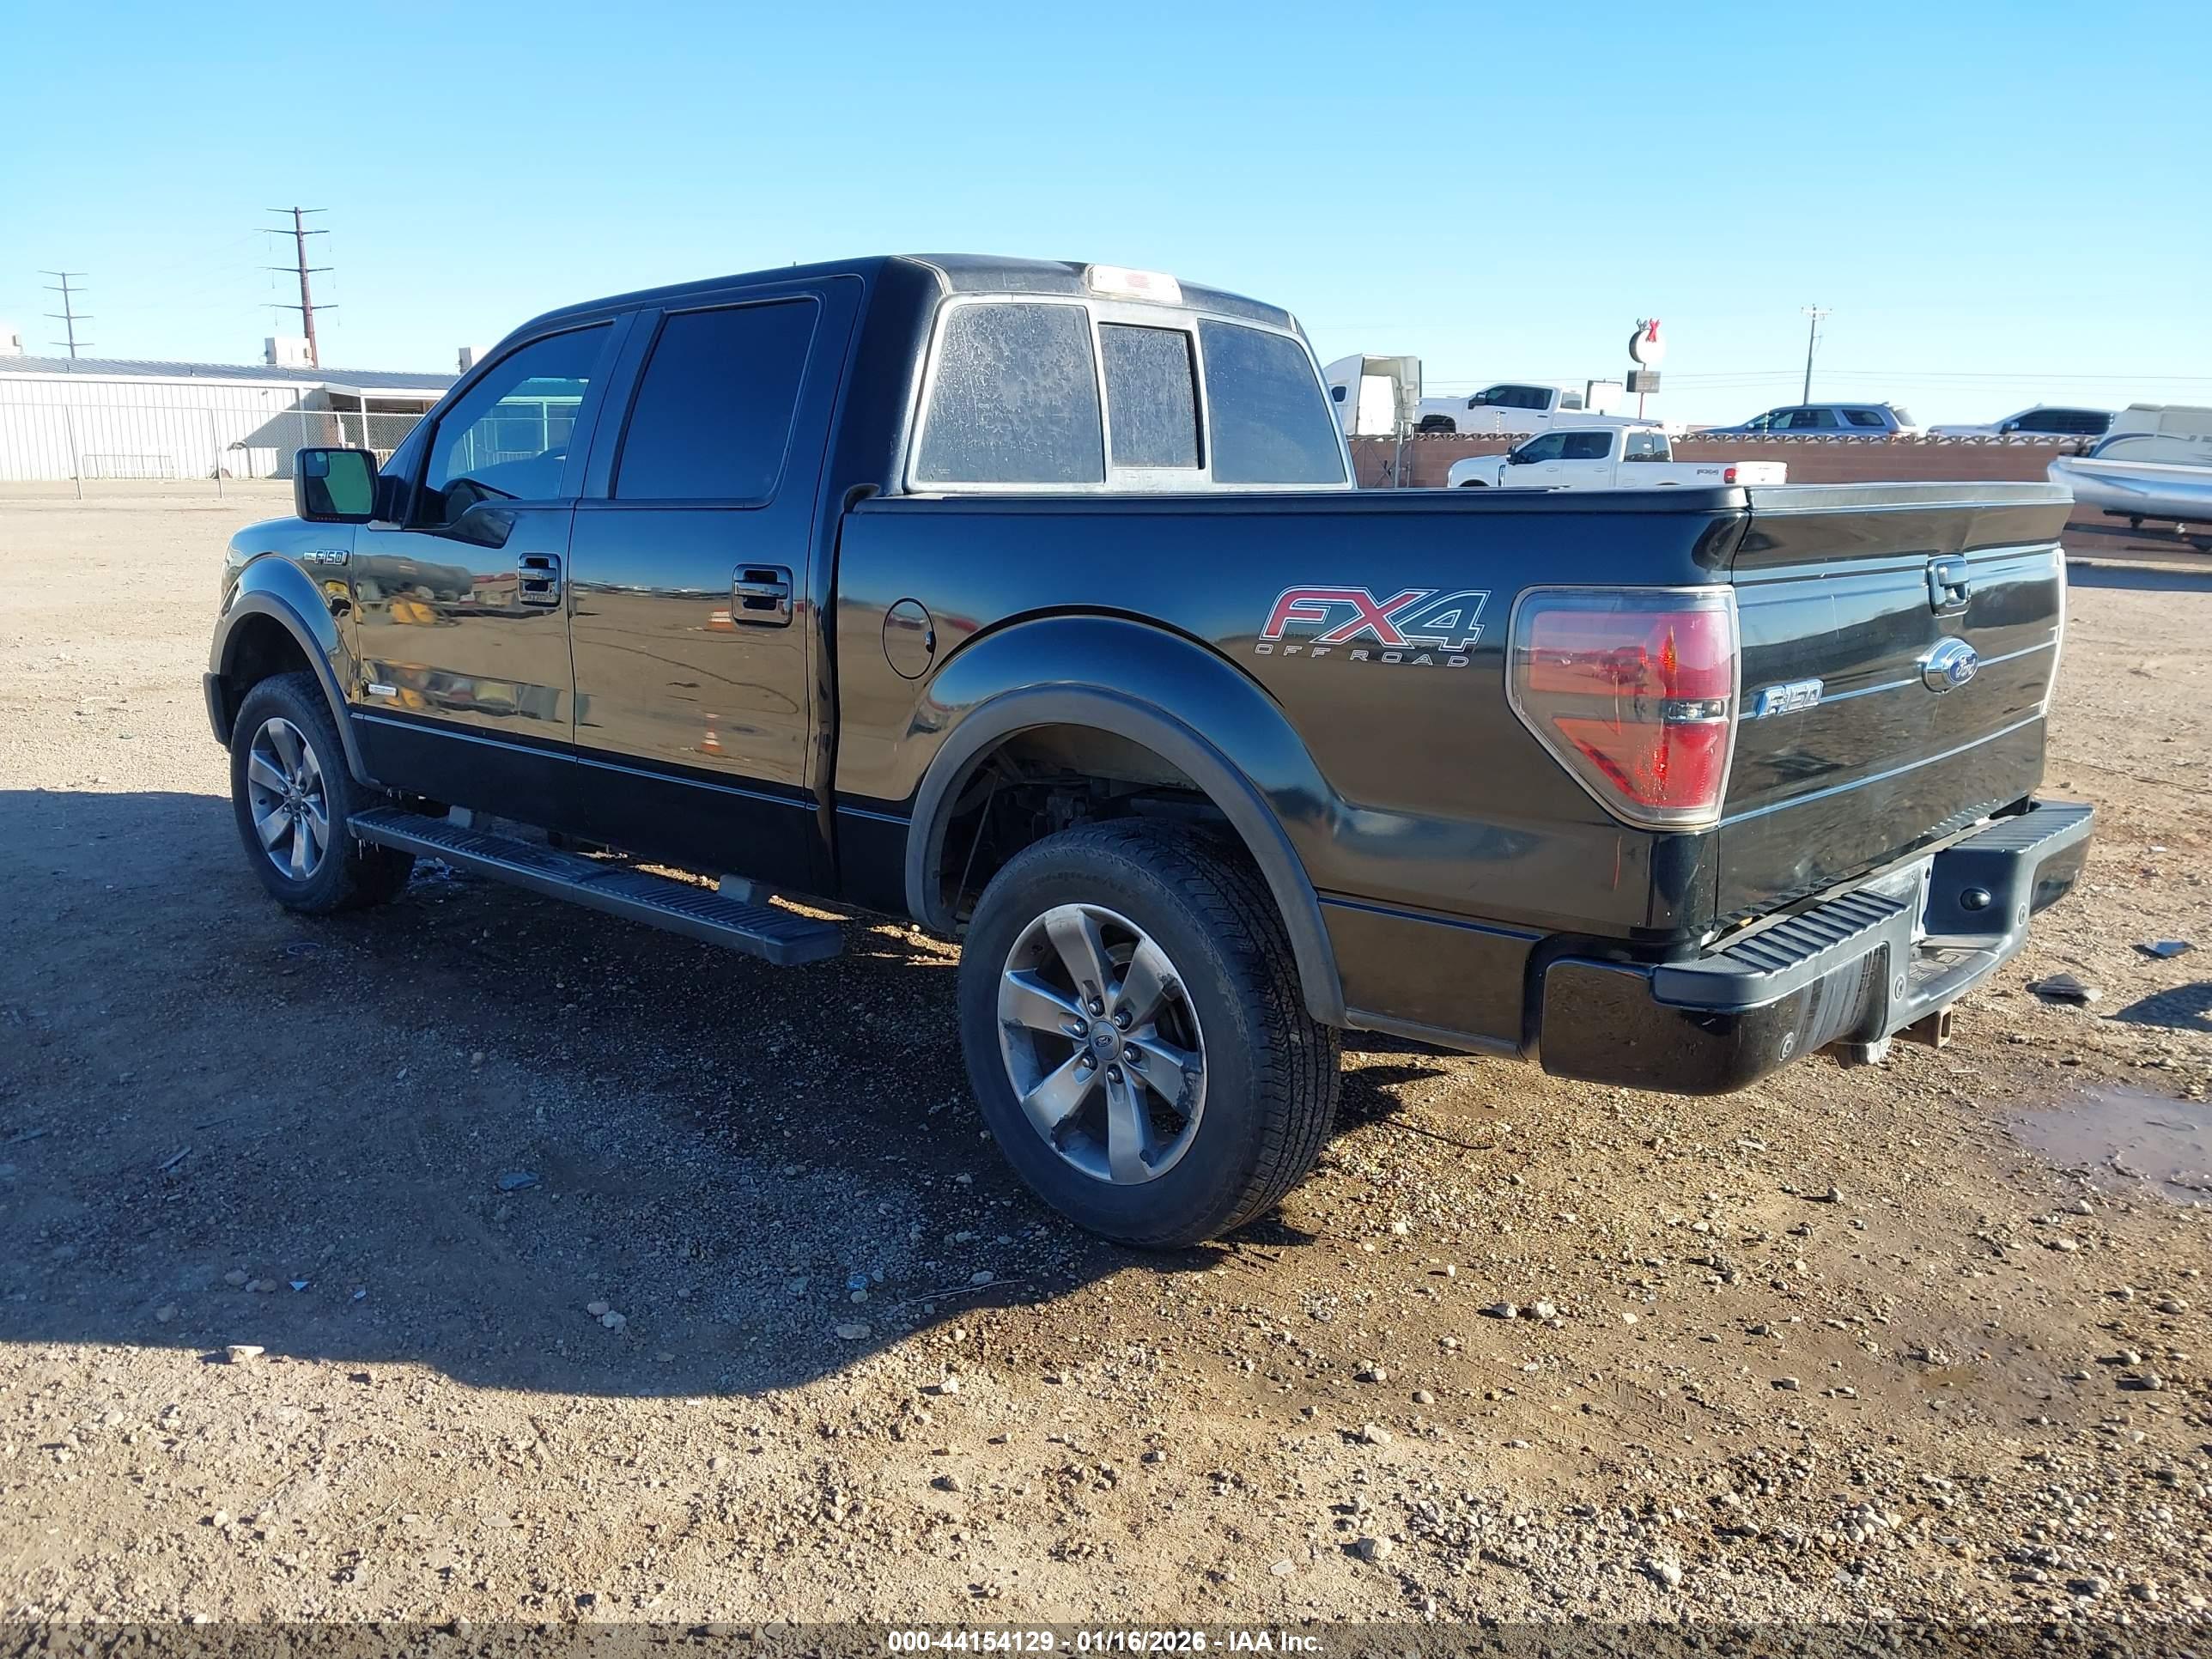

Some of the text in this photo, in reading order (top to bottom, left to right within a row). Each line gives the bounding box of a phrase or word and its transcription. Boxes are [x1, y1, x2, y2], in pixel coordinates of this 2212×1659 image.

[1259, 585, 1492, 653] FX4
[1254, 644, 1470, 667] OFF ROAD
